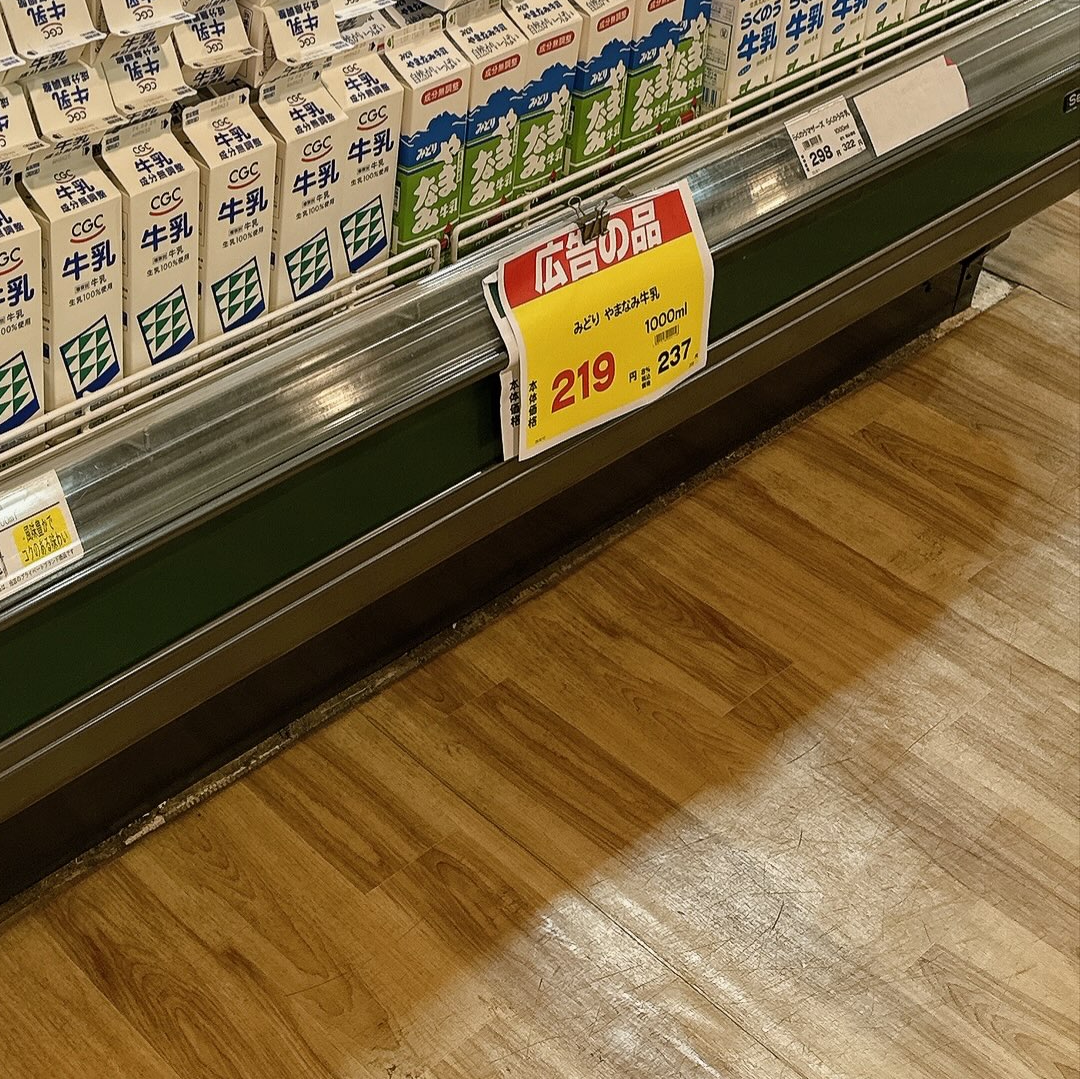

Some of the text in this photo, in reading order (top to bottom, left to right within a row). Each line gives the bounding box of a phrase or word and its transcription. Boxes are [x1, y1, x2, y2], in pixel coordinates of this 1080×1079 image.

[741, 0, 781, 31] らくのう
[737, 23, 778, 61] 牛乳
[416, 142, 438, 160] みどり
[809, 144, 834, 167] 298
[841, 139, 856, 153] 322
[71, 214, 104, 239] CGC
[439, 199, 458, 219] 牛乳
[62, 239, 116, 281] 牛乳
[535, 200, 663, 295] 広告の品
[573, 286, 661, 336] みどり やまなみ牛乳
[645, 301, 688, 334] 1000ml
[657, 337, 692, 375] 237
[551, 350, 637, 414] 219 円
[527, 380, 538, 429] 本体価格
